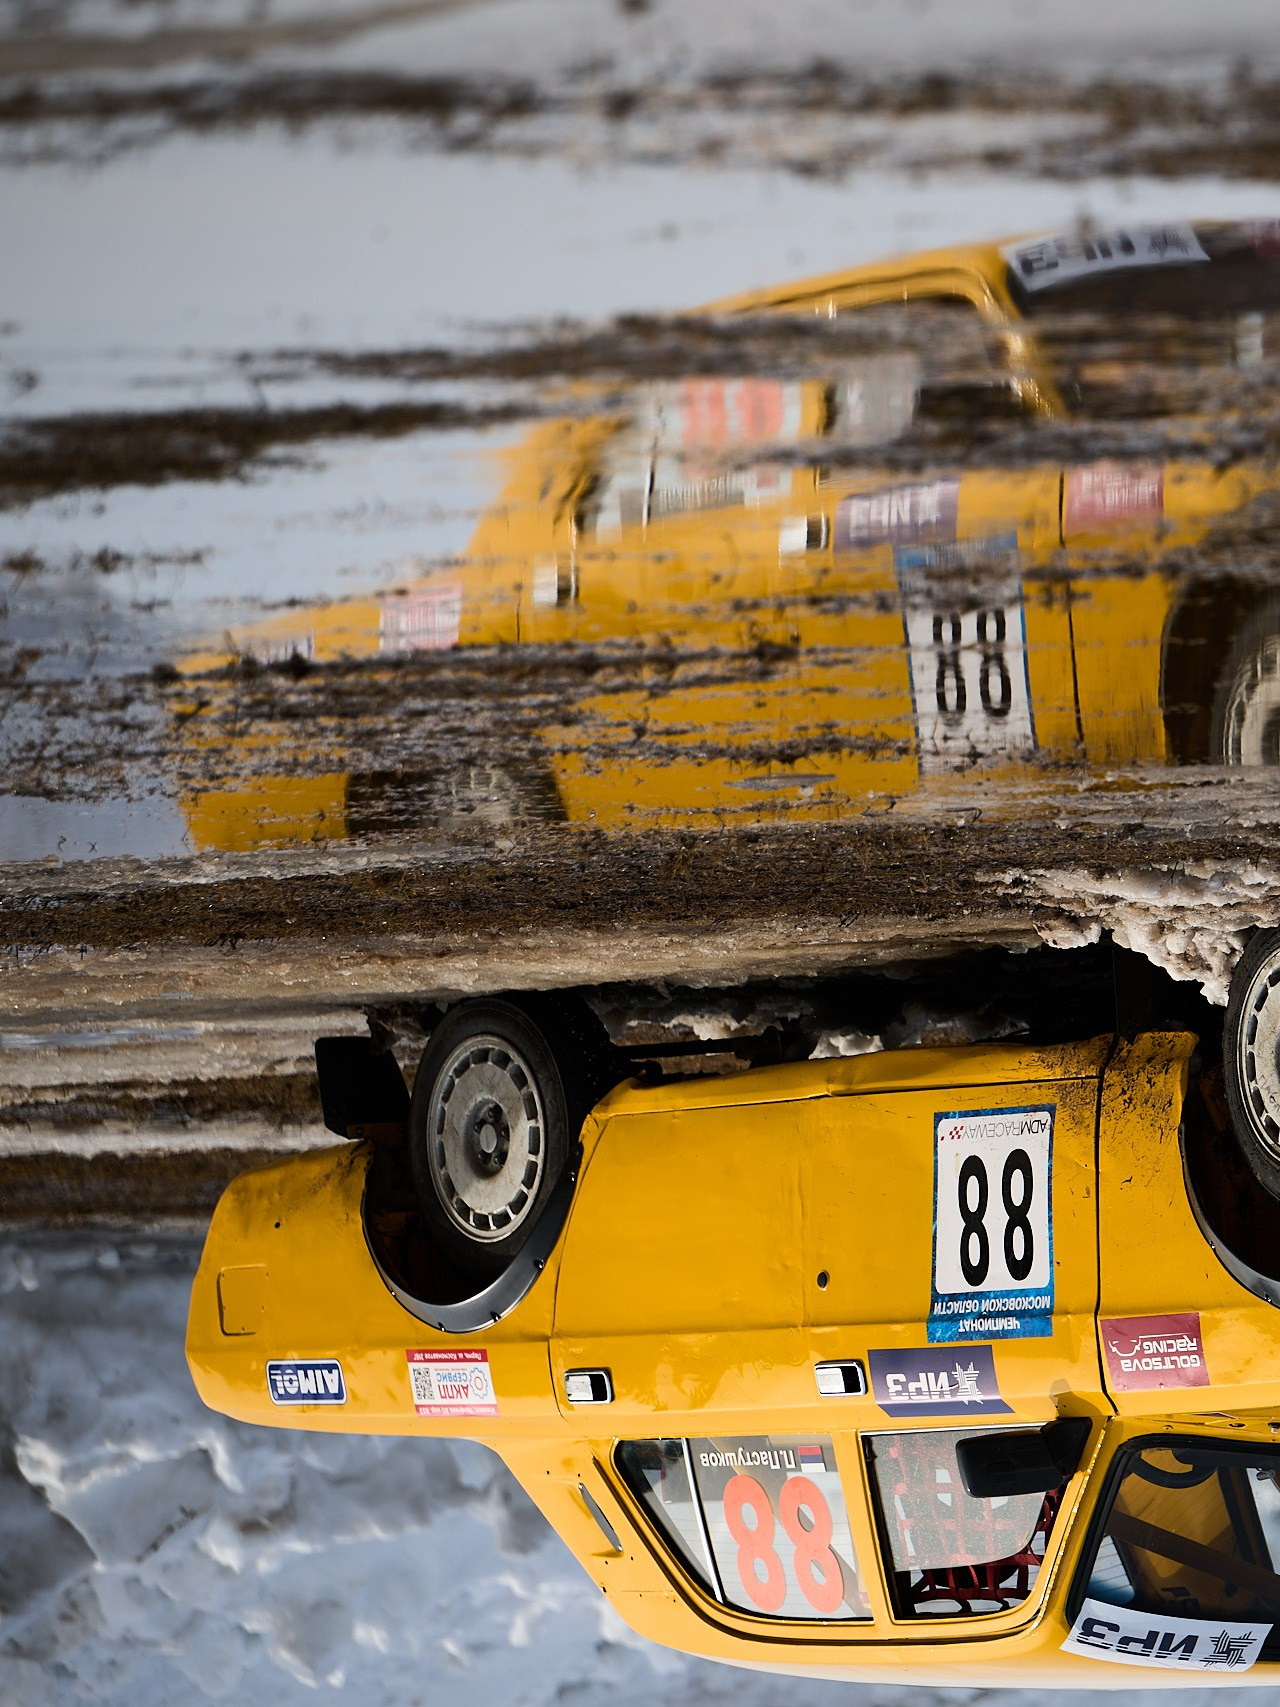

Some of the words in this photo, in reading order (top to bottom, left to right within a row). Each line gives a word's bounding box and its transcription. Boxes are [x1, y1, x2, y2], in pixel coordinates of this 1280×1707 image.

[961, 1119, 1048, 1140] ADMRACEWAY
[957, 1148, 1034, 1287] 88
[933, 1299, 979, 1315] ОБЛАСТИ
[981, 1295, 1050, 1315] МОСКОВСКОЙ
[958, 1317, 1020, 1332] ЧЕМПИОНАТ
[1142, 1335, 1197, 1354] RACING
[1120, 1354, 1200, 1372] GOLTSOVA
[270, 1369, 339, 1395] AIMOL
[435, 1372, 468, 1383] СЕРВИС
[885, 1372, 951, 1401] ИРЗ
[437, 1384, 469, 1400] АКПП
[699, 1447, 797, 1470] П.Пастушков
[722, 1474, 844, 1614] 88
[1076, 1617, 1199, 1661] ИРЗ
